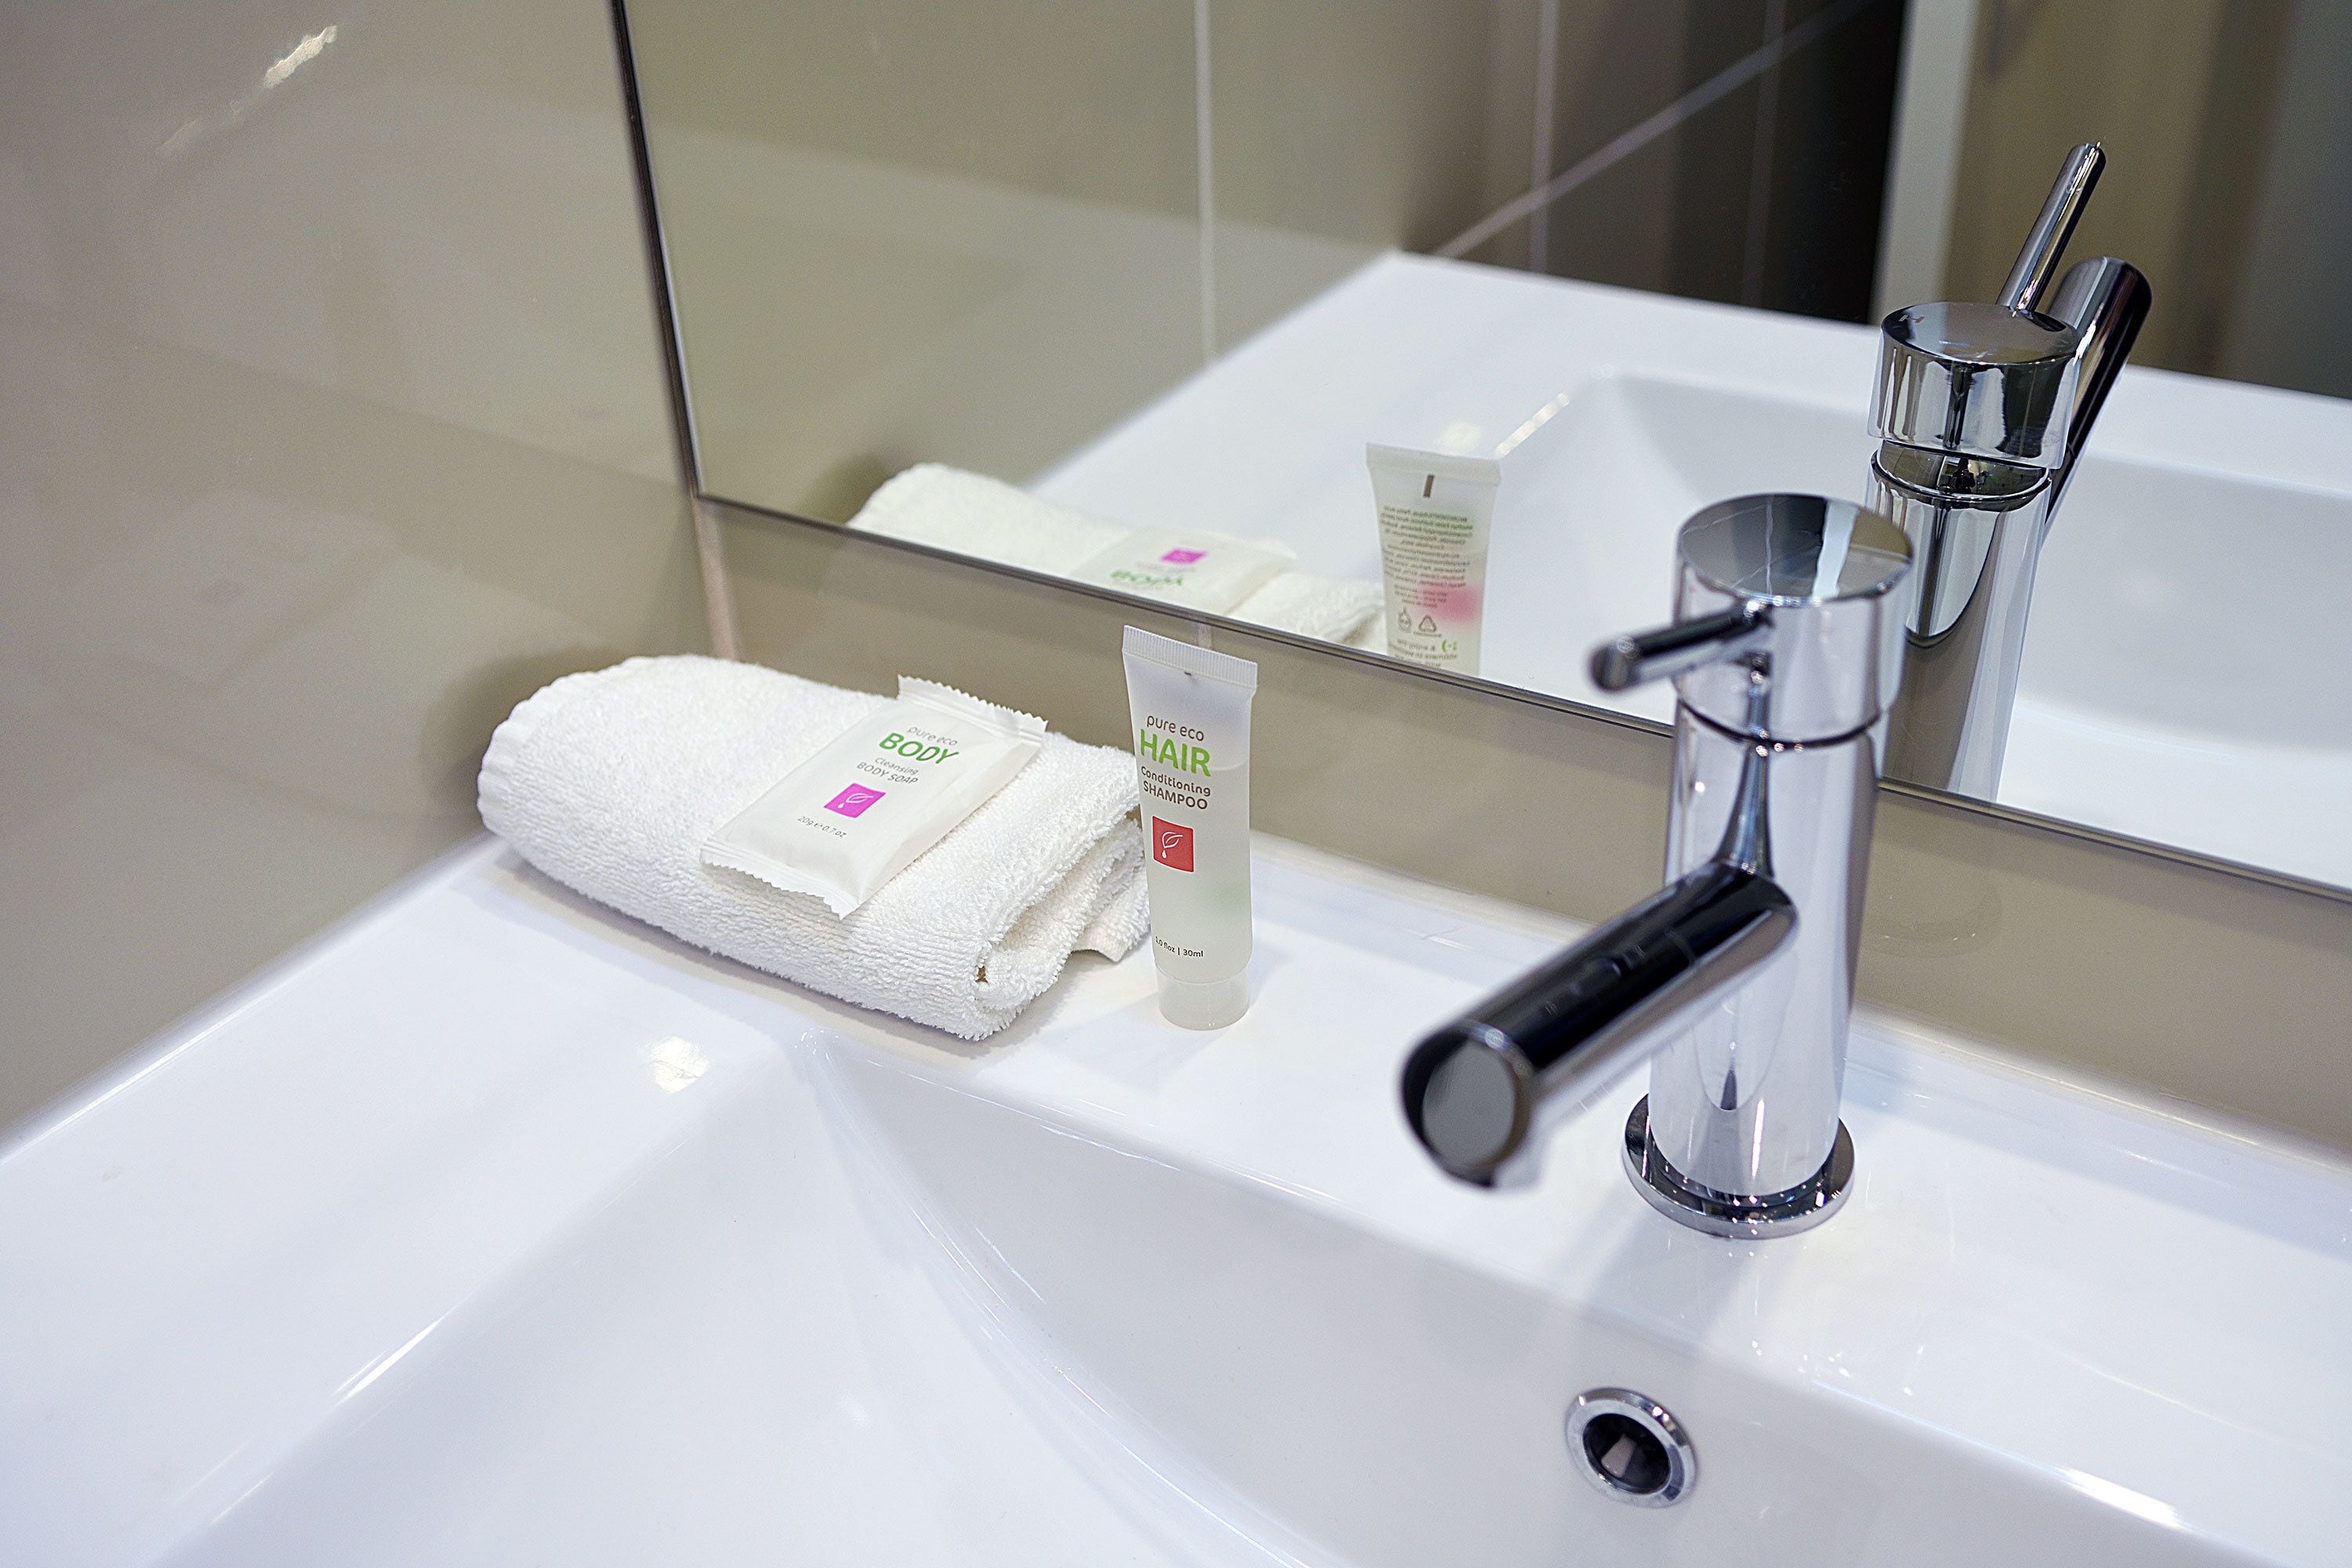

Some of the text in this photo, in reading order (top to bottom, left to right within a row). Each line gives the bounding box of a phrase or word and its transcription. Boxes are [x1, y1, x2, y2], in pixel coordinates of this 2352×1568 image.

[906, 726, 958, 746] pure eco
[1147, 715, 1204, 742] pure eco
[879, 732, 960, 764] BODY
[1140, 728, 1211, 777] HAIR
[857, 761, 919, 785] BODY SOAP
[874, 757, 919, 775] Cleansing
[1141, 766, 1210, 797] Conditioning
[1143, 781, 1208, 809] SHAMPOO
[797, 815, 814, 826] 20g
[1183, 949, 1203, 957] 30ml
